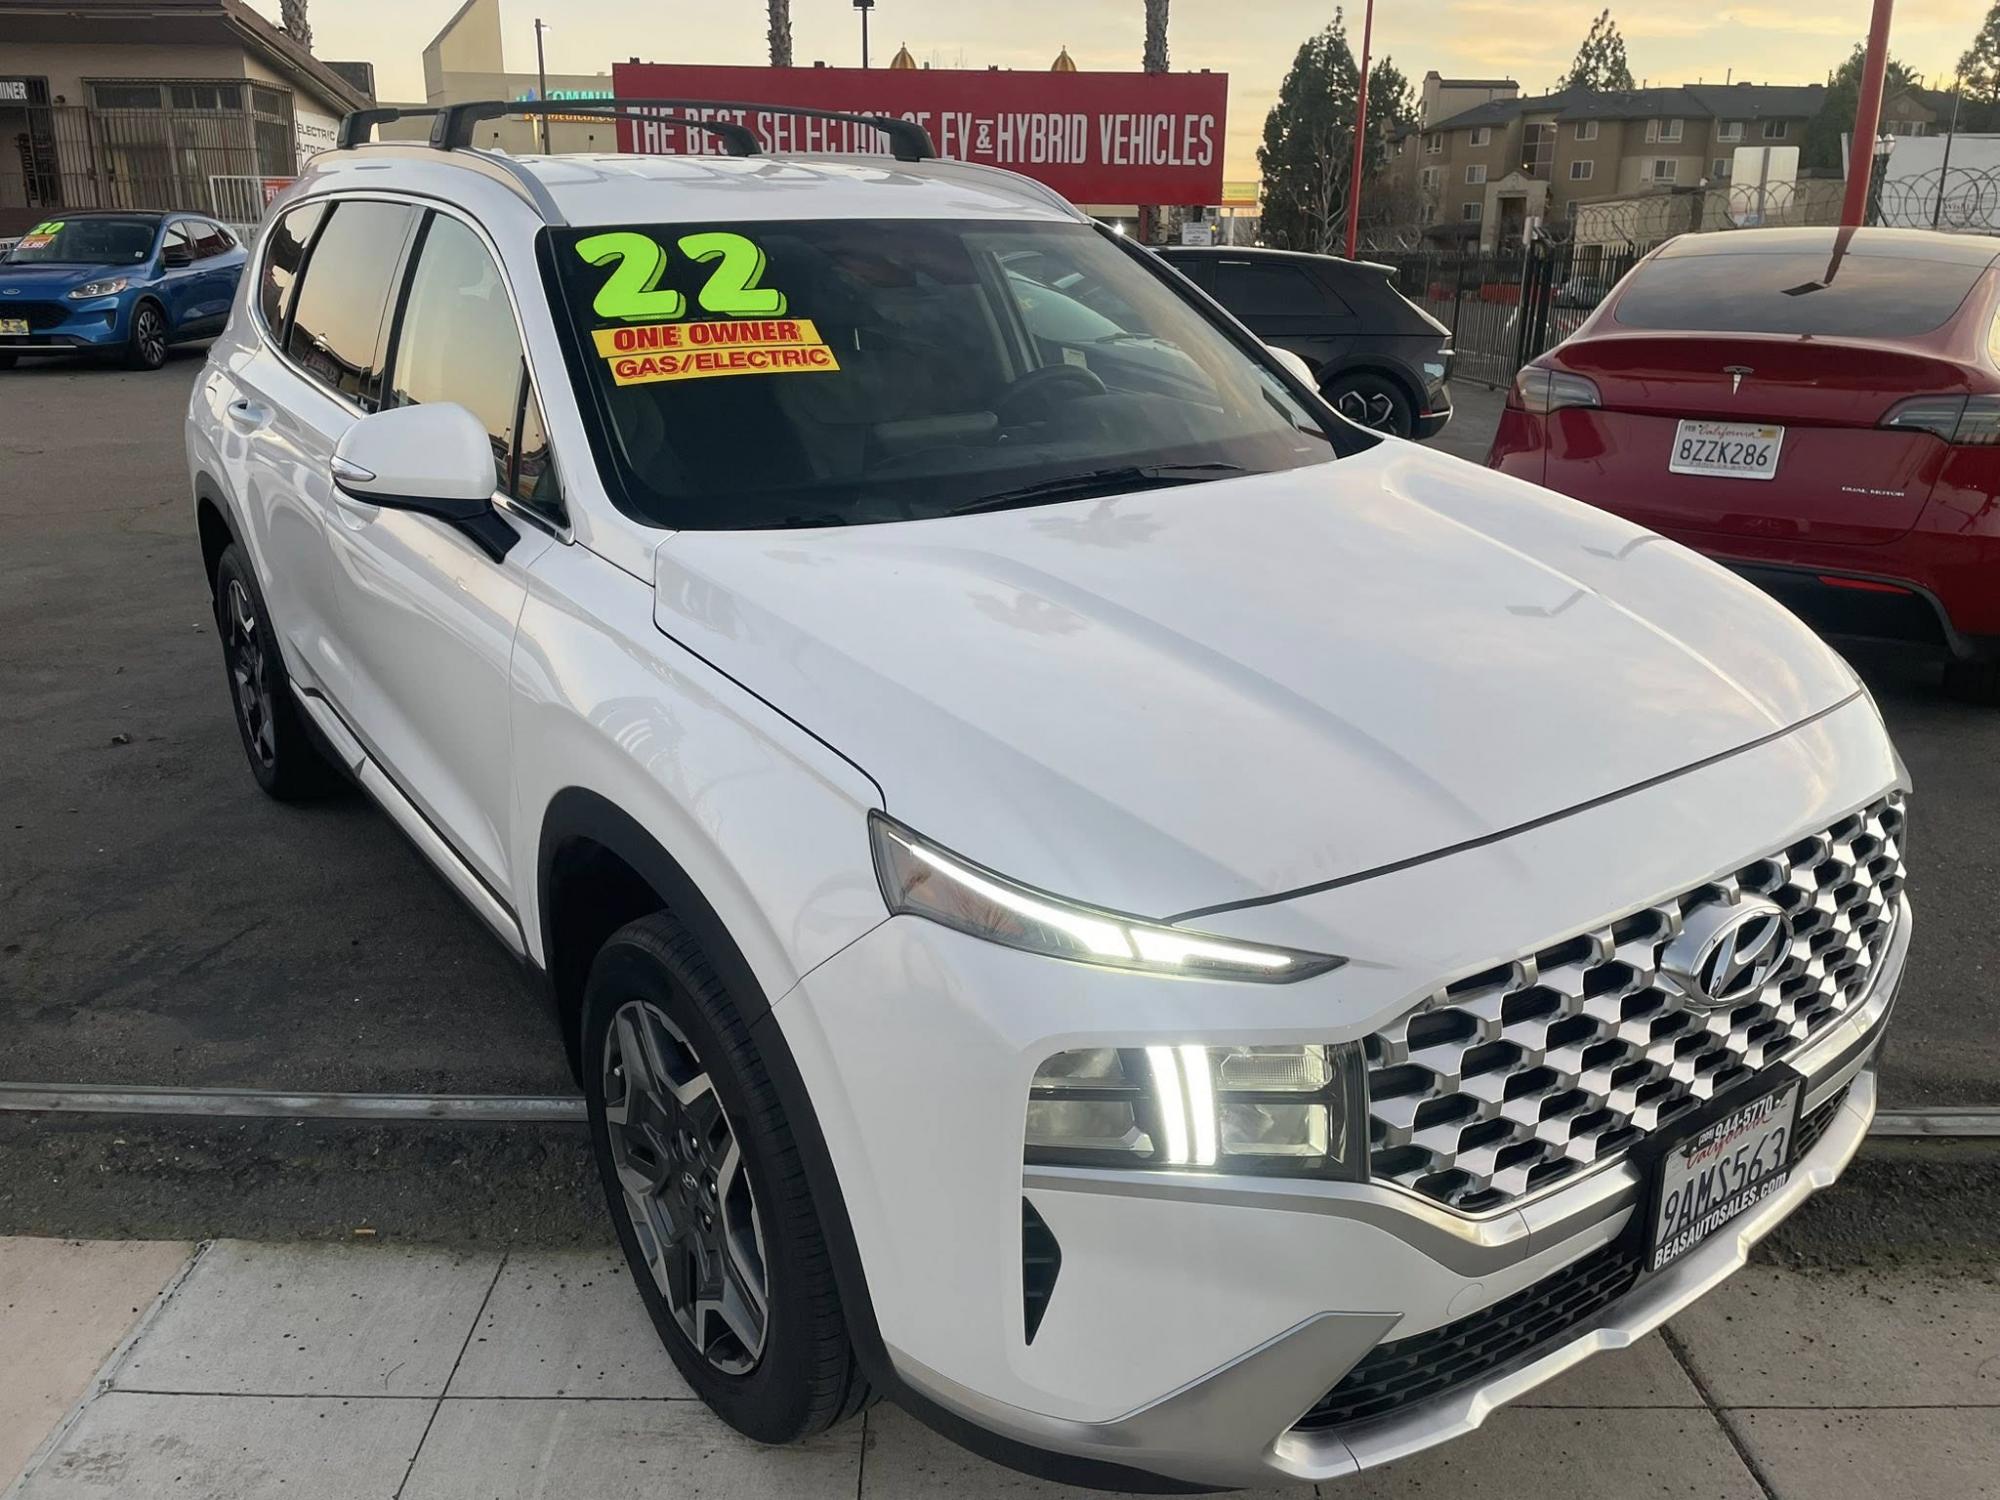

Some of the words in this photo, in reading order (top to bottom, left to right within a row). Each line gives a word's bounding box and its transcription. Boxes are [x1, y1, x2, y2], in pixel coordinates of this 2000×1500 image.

[297, 123, 336, 142] ELECTRIC
[627, 107, 675, 153] THE
[757, 111, 892, 155] SELECTION
[941, 112, 972, 161] EV
[997, 113, 1088, 164] HYBRID
[1099, 114, 1214, 166] VEHICLES
[575, 232, 787, 322] 22
[613, 325, 683, 351] ONE
[688, 321, 801, 345] OWNER
[615, 348, 831, 379] GAS/ELECTRIC
[1679, 438, 1772, 467] 8ZZK286
[1663, 1127, 1786, 1240] 9AMS563
